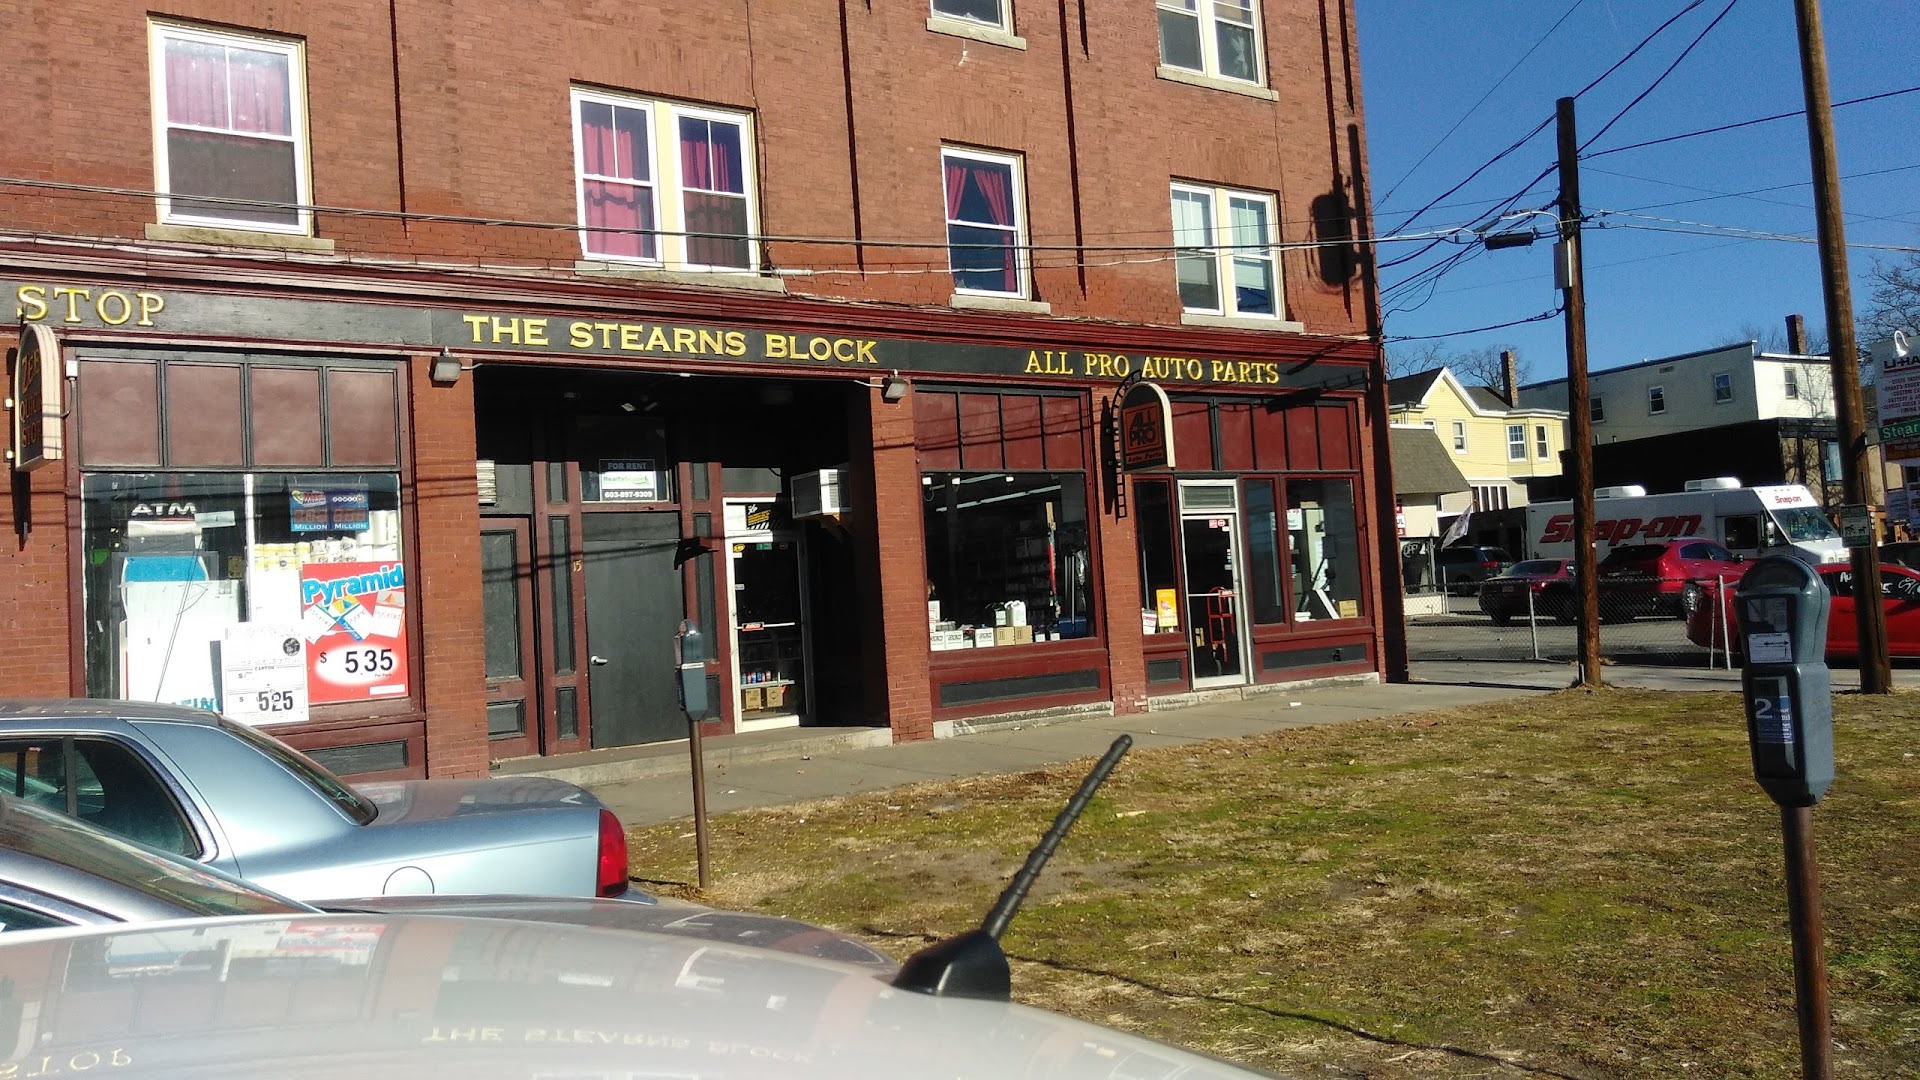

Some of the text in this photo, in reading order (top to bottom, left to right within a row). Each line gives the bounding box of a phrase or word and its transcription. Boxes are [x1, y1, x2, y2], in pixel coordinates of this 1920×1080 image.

[16, 285, 165, 327] STOP
[462, 314, 878, 364] THE STEARNS BLOCK
[1024, 350, 1280, 384] ALL PRO AUTO PARTS
[1129, 426, 1158, 448] PRO
[1882, 423, 1920, 439] Stear
[607, 462, 647, 470] FOR RENT
[131, 502, 197, 516] ATM
[1774, 495, 1802, 504] Snap-on
[334, 522, 367, 530] MILLION
[1539, 513, 1702, 546] Sap-on
[302, 563, 405, 606] Pyramid
[319, 651, 328, 664] $
[1754, 698, 1773, 719] 2
